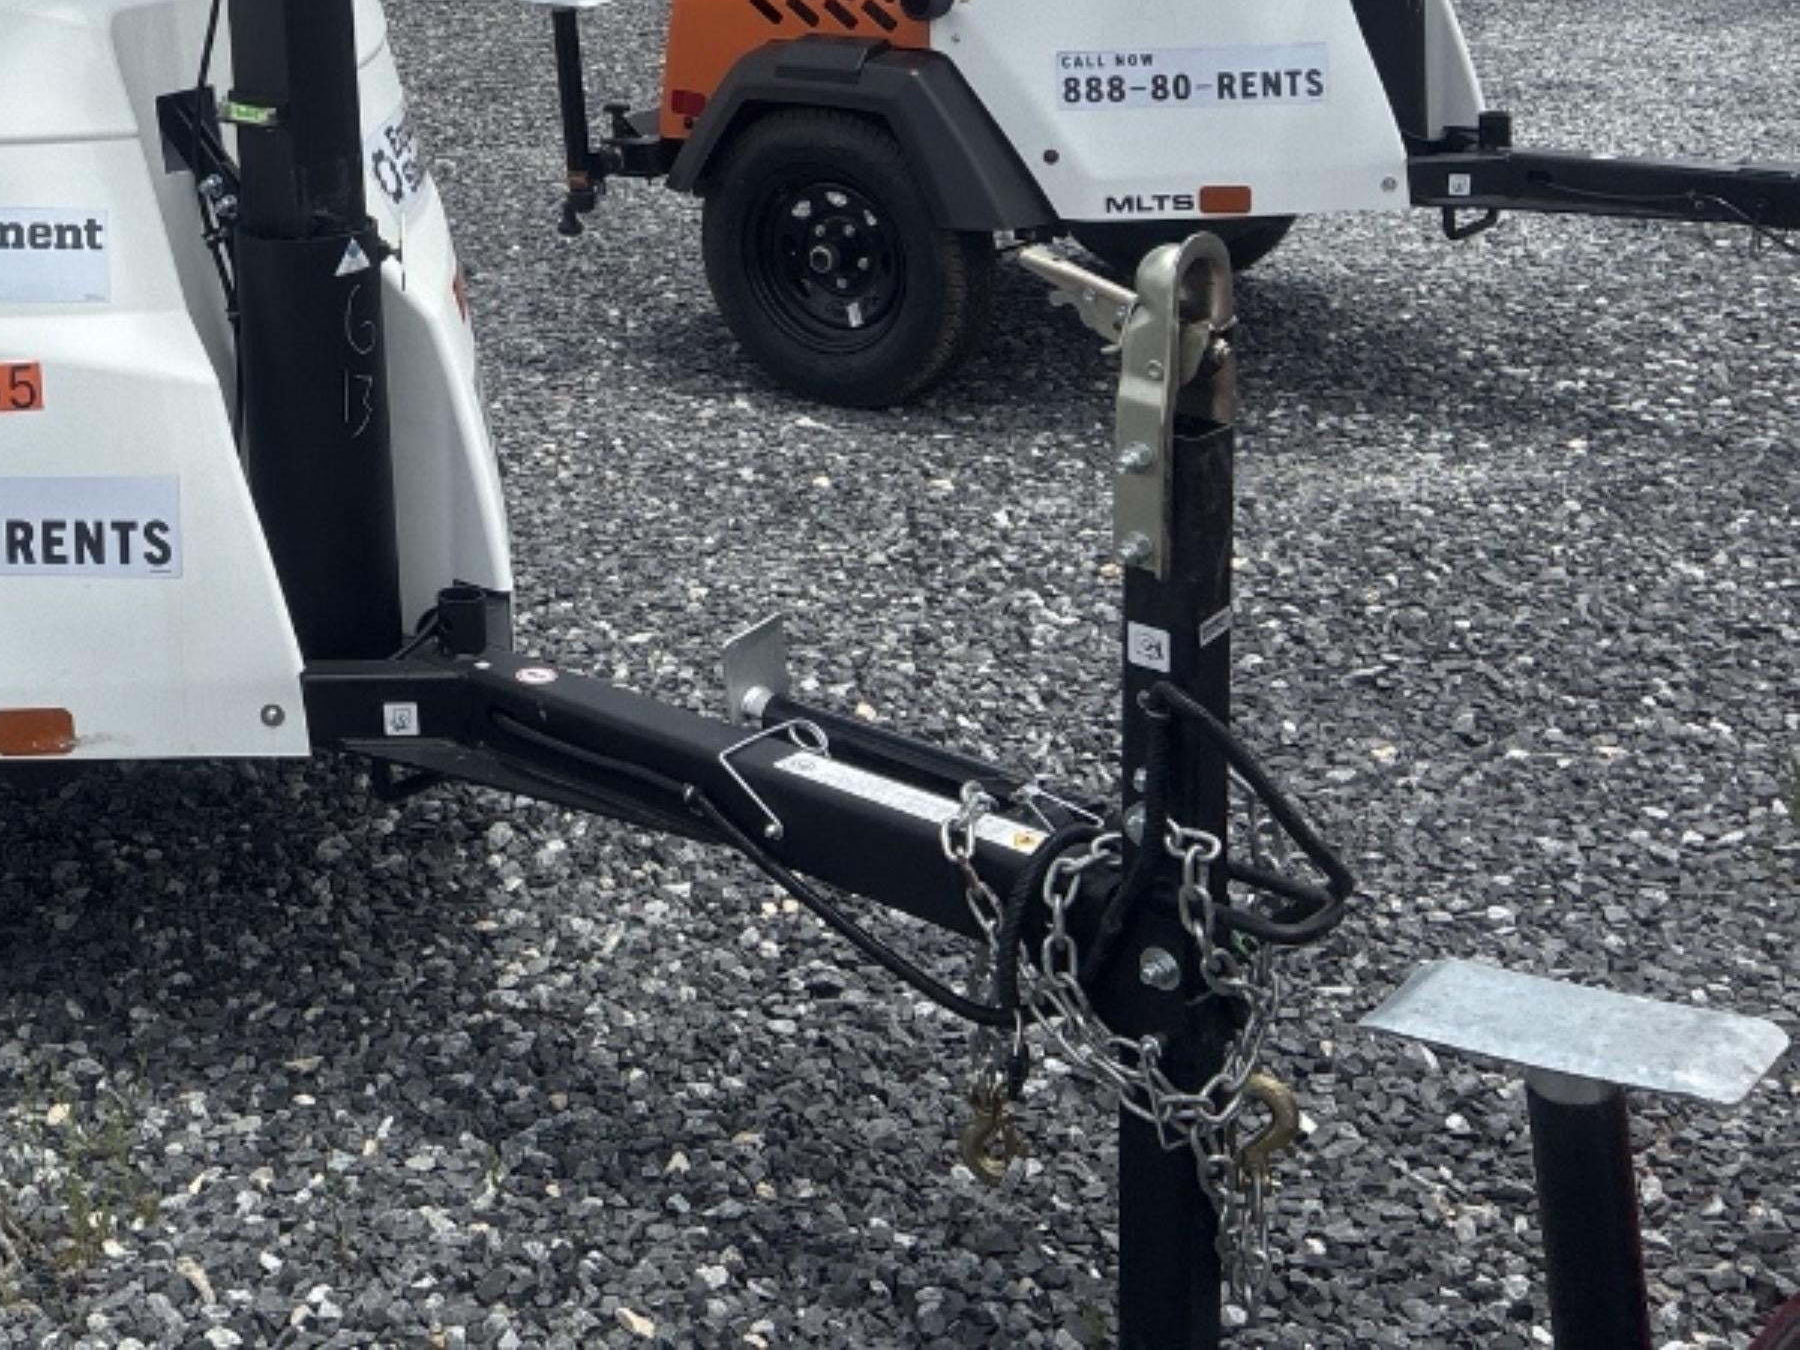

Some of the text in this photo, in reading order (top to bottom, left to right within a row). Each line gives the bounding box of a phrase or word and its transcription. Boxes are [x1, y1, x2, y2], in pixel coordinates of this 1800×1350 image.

[1061, 53, 1154, 69] CALL NOW
[1062, 68, 1325, 104] 888-80-RENTS
[1105, 194, 1195, 214] MLTS
